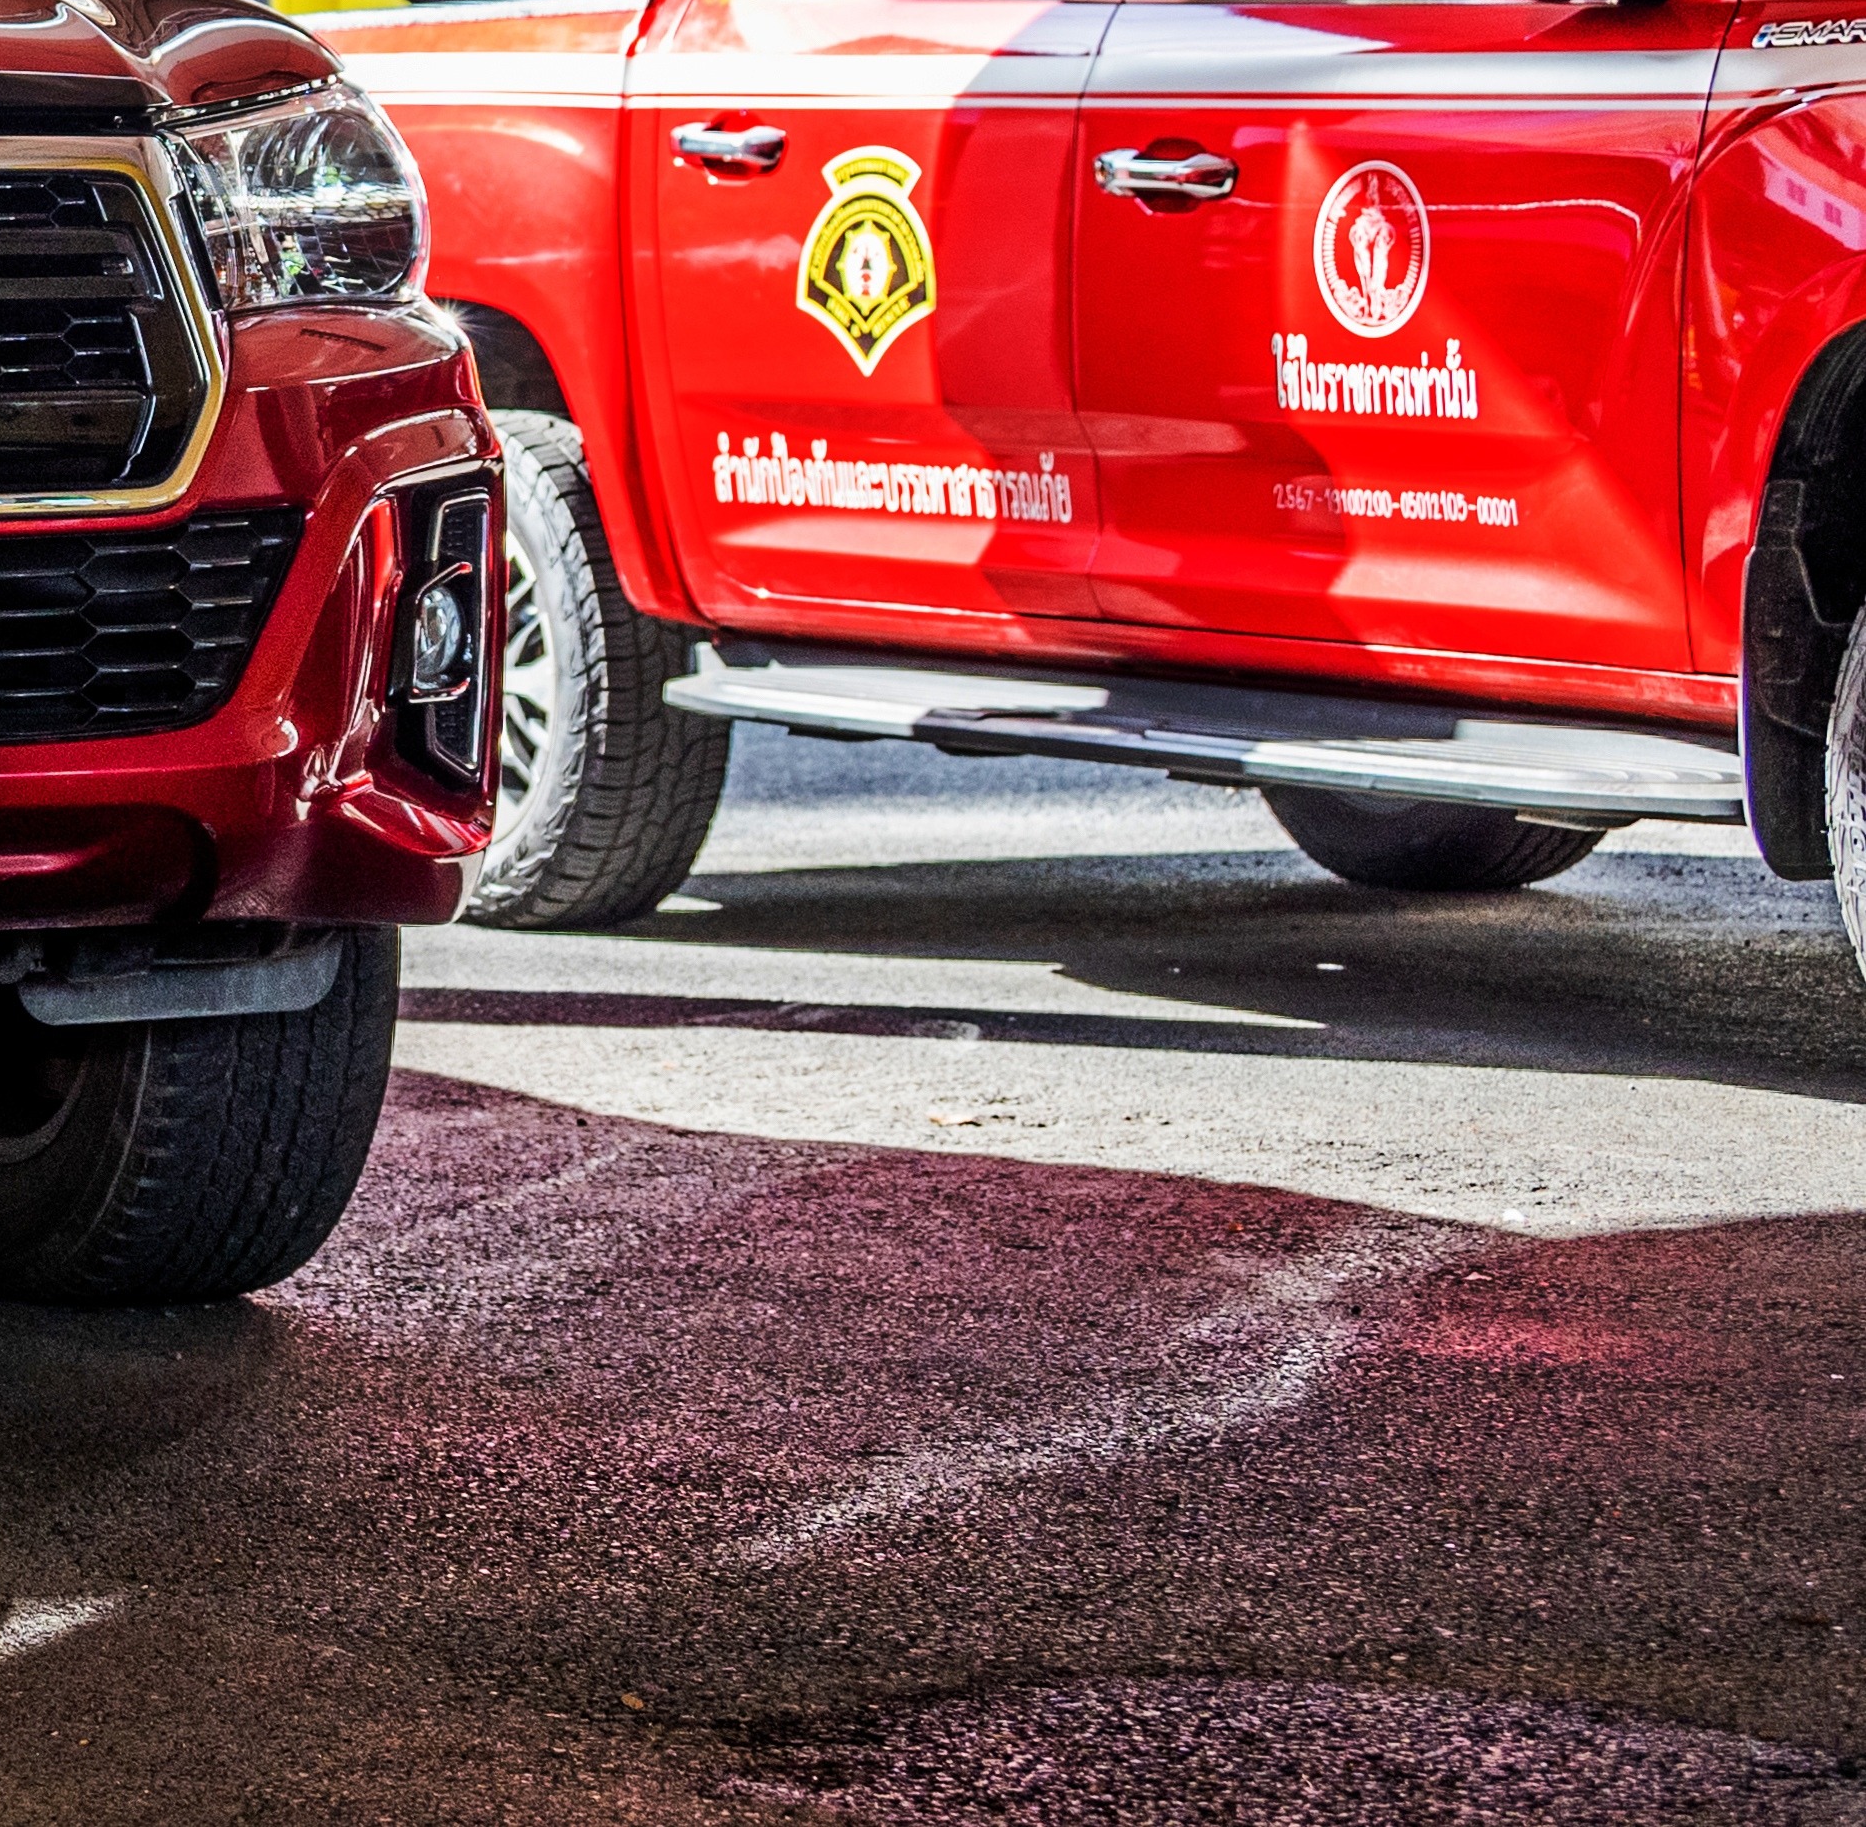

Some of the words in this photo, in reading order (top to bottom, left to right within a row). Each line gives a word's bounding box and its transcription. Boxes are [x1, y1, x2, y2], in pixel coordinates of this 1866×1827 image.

[1271, 332, 1478, 420] ใช้ในราชการเท่านั้น
[713, 431, 1072, 524] สำนักป้องกันและบรรเทาสาธารณภัย
